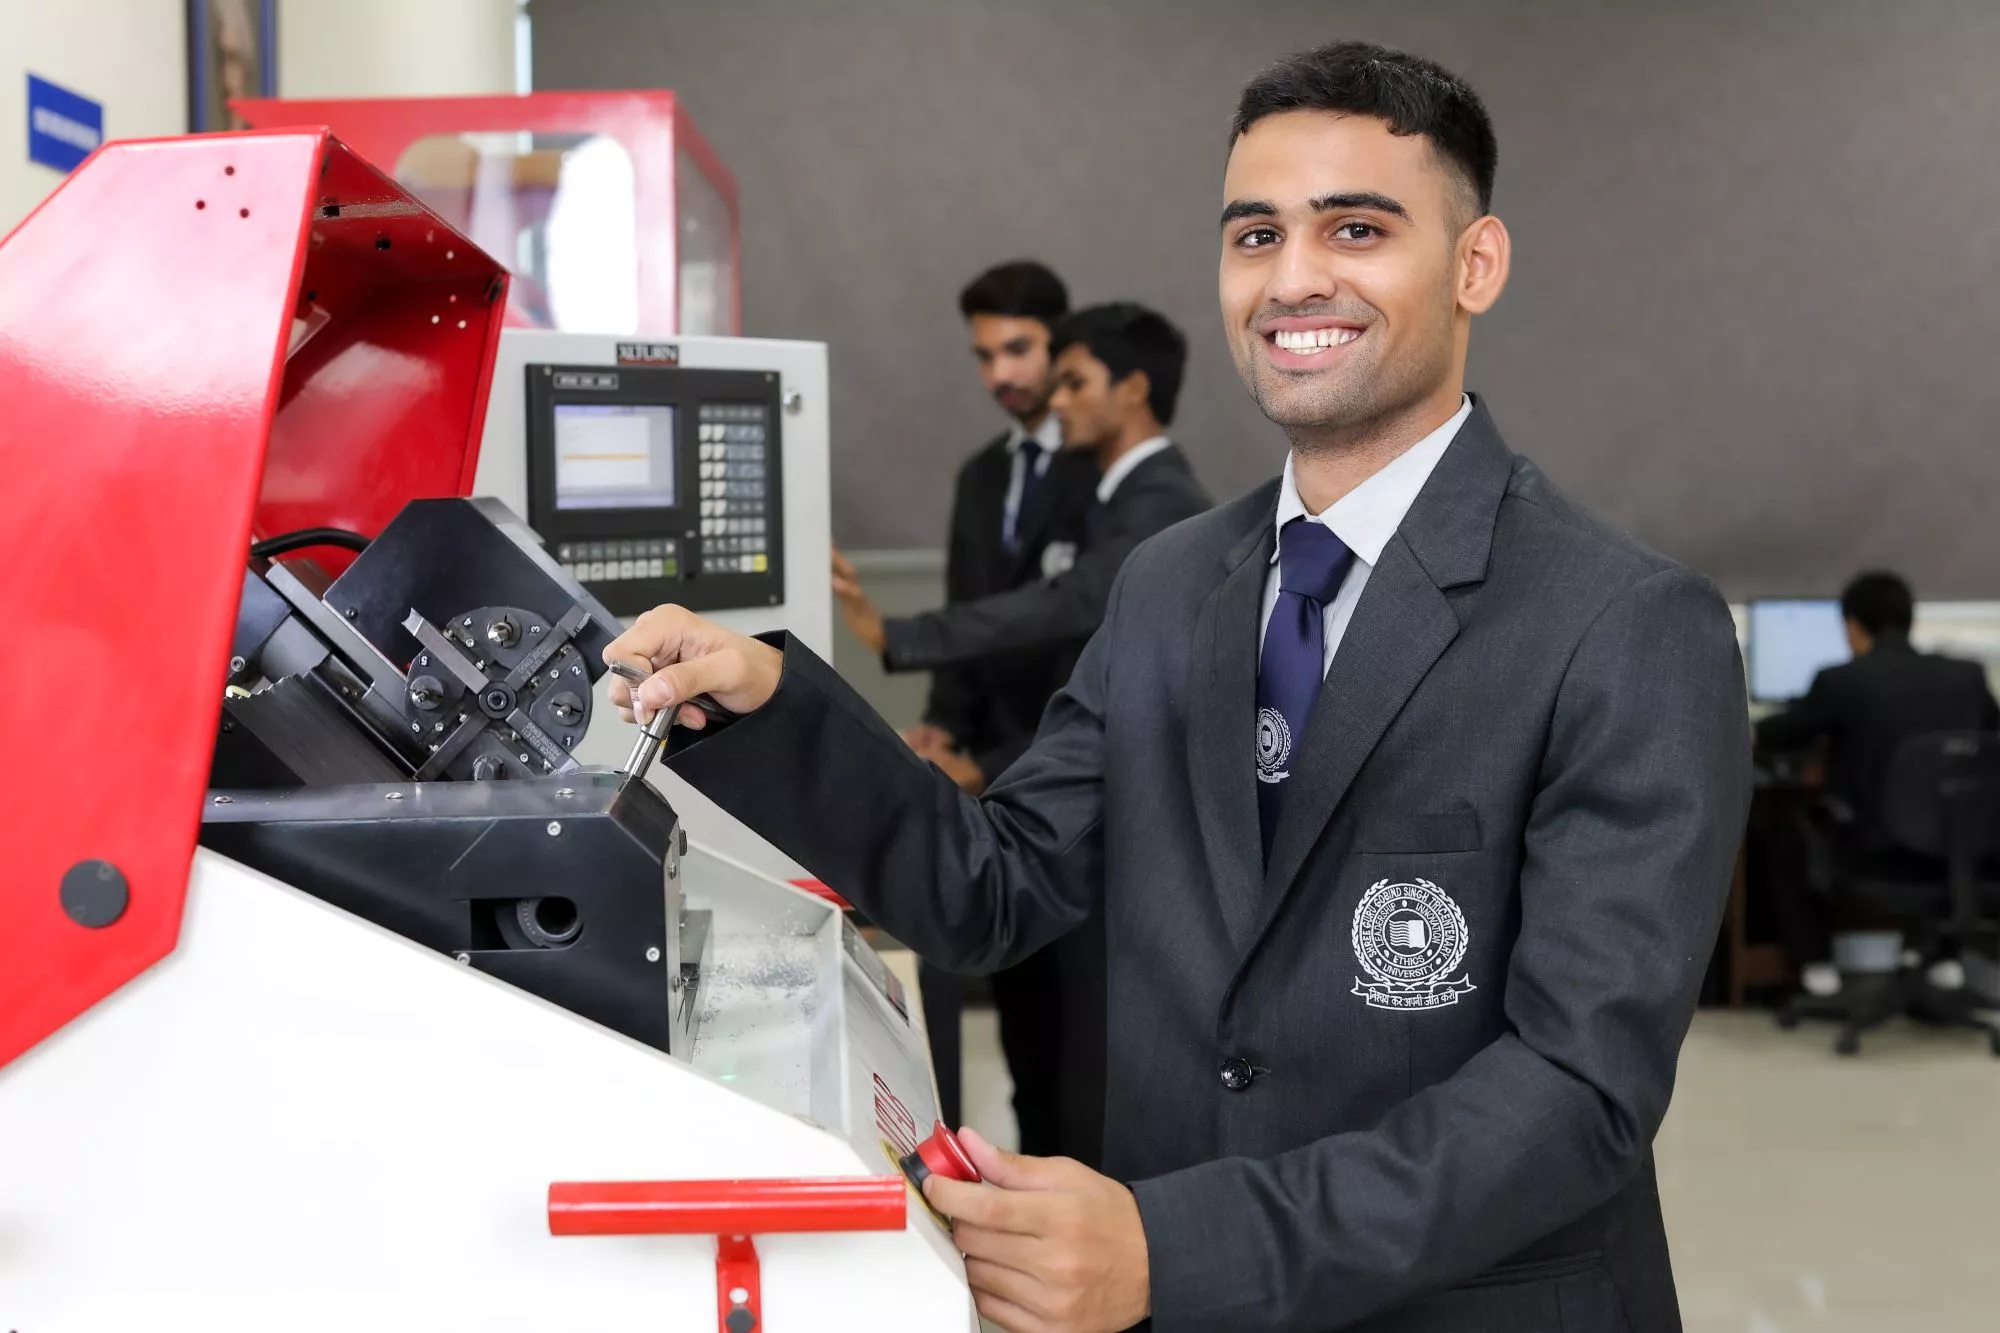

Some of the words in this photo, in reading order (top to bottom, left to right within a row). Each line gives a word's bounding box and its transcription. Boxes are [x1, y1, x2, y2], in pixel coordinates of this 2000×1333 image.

[530, 624, 540, 633] 3
[571, 665, 582, 676] 2
[566, 736, 571, 746] 1
[1374, 887, 1402, 907] GOBIND
[1403, 886, 1430, 902] SINGH
[1363, 904, 1377, 929] GURU
[1374, 903, 1396, 948] LEADERSHIP
[1415, 903, 1442, 945] INNOVATION
[1428, 897, 1456, 960] TRICENTENARY
[1363, 930, 1377, 958] SHREE
[1393, 955, 1425, 966] ETHICS
[1382, 963, 1434, 978] UNIVERSITY
